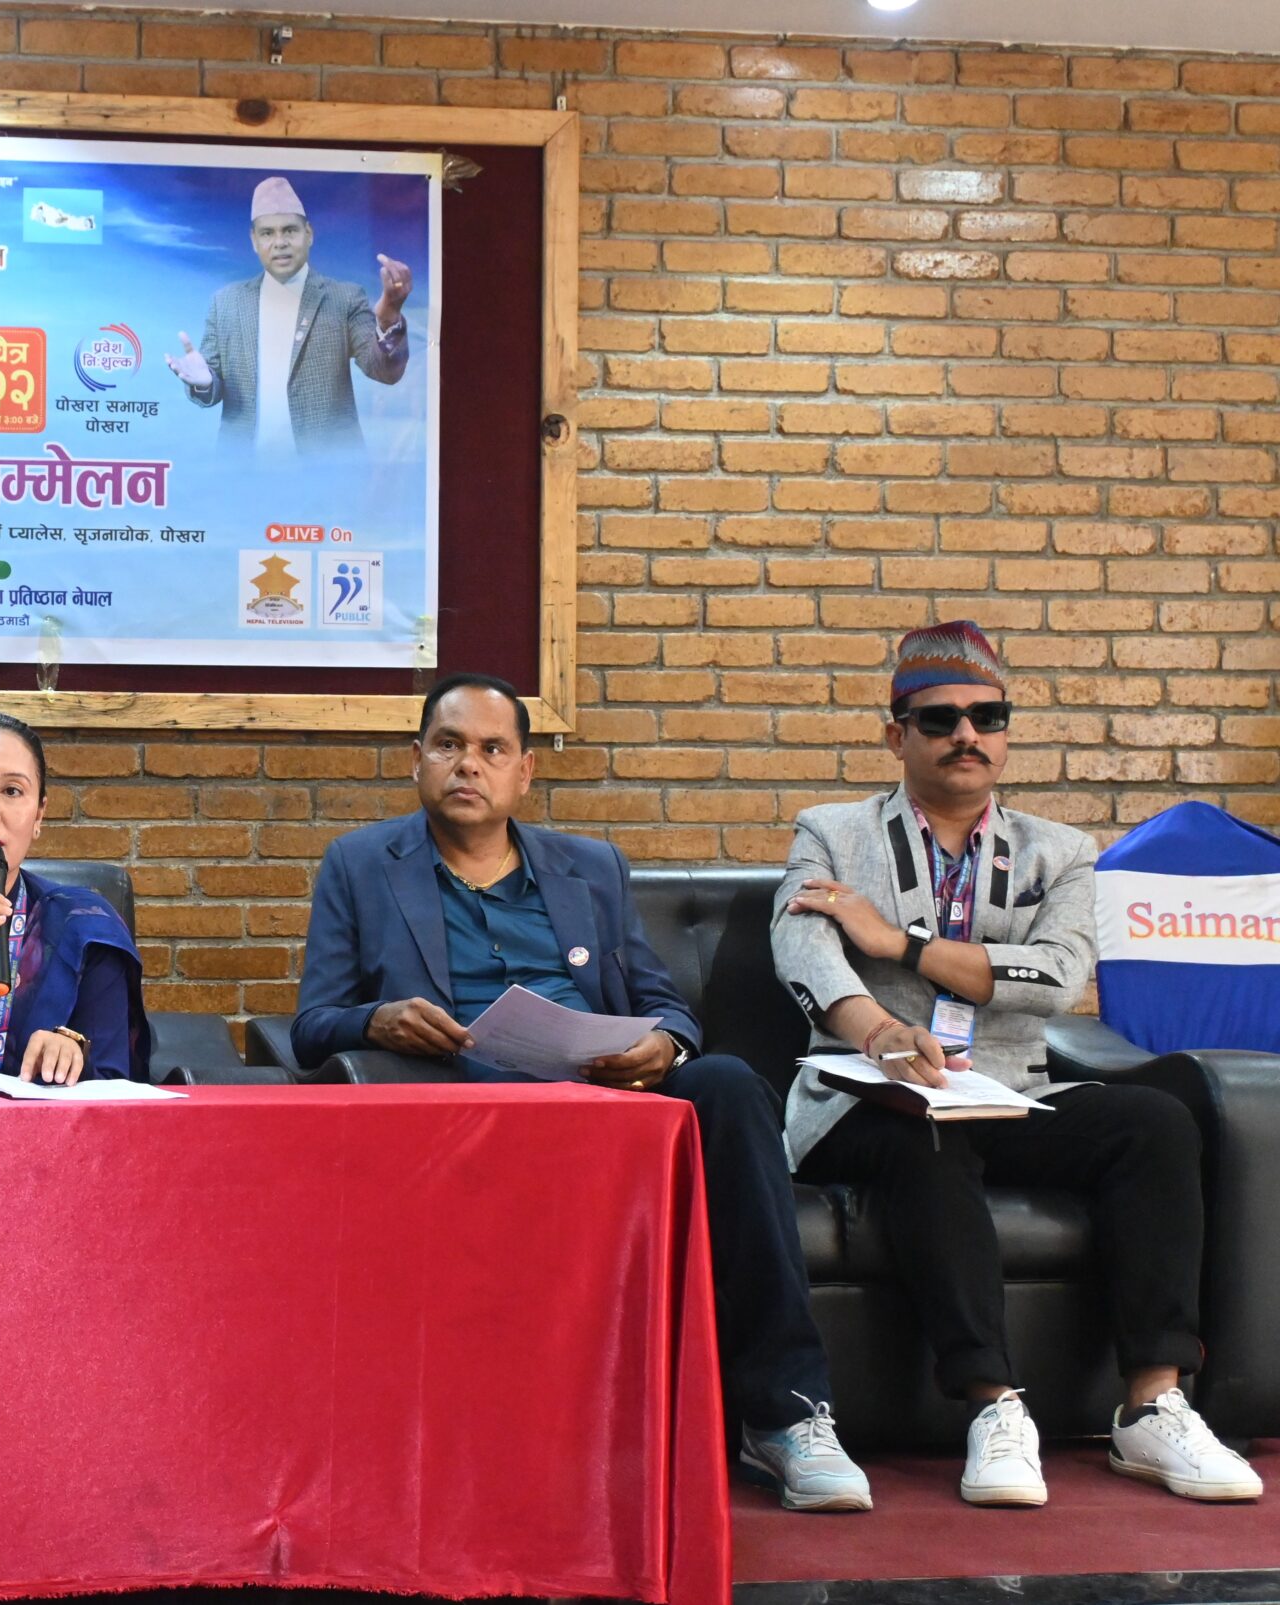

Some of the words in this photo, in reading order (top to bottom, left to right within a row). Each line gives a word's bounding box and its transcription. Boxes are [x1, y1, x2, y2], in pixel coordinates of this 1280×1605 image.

[93, 340, 122, 355] प्रवेश
[55, 395, 99, 413] पोखरा
[106, 400, 160, 418] सभागृह
[85, 417, 130, 434] पोखरा
[160, 525, 206, 543] पोखरा
[286, 527, 320, 541] LIVE
[330, 527, 353, 543] On
[9, 585, 68, 607] प्रतिष्ठान
[72, 587, 113, 607] नेपाल
[334, 612, 371, 622] PUBLIC
